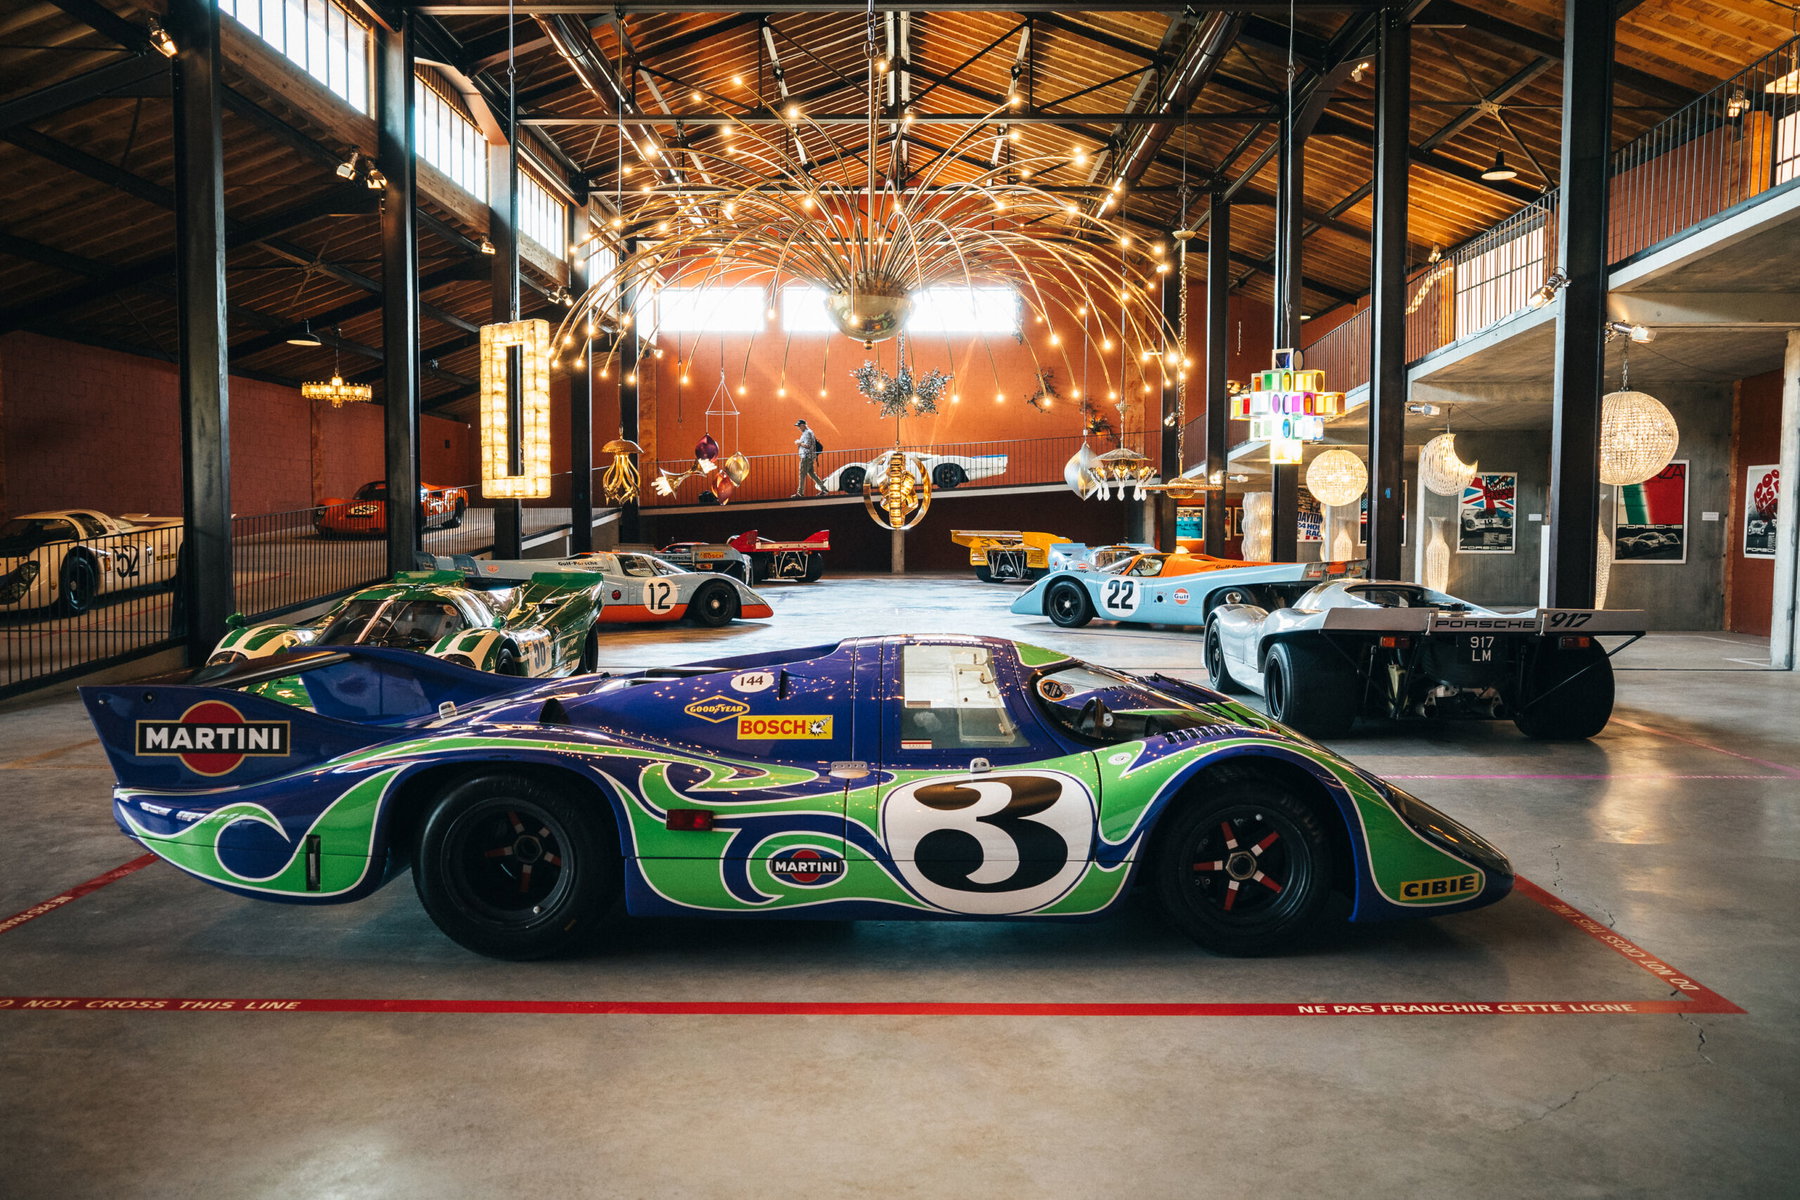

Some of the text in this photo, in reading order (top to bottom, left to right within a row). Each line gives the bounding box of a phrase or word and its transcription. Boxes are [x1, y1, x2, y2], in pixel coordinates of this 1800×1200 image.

[1297, 511, 1323, 523] DAYTON
[110, 544, 140, 577] 52
[648, 582, 671, 610] 12
[1107, 579, 1134, 609] 22
[1435, 612, 1593, 629] PORSCHE 917
[1470, 636, 1494, 649] 917
[1472, 650, 1492, 662] LM
[740, 675, 764, 686] 144
[690, 703, 743, 714] GOODYEAR
[740, 719, 806, 735] BOSCH
[145, 727, 281, 750] MARTINI
[913, 775, 1069, 894] 3
[775, 860, 838, 873] MARTINI
[1404, 875, 1475, 897] CIBIE
[1600, 935, 1646, 958] CROSS
[1639, 959, 1677, 976] NOT
[1669, 978, 1700, 991] DO
[0, 1000, 302, 1010] O NOT CROSS THIS LINE
[1298, 1004, 1637, 1014] NE PAS FRANCHIR CETTE LIGNE
